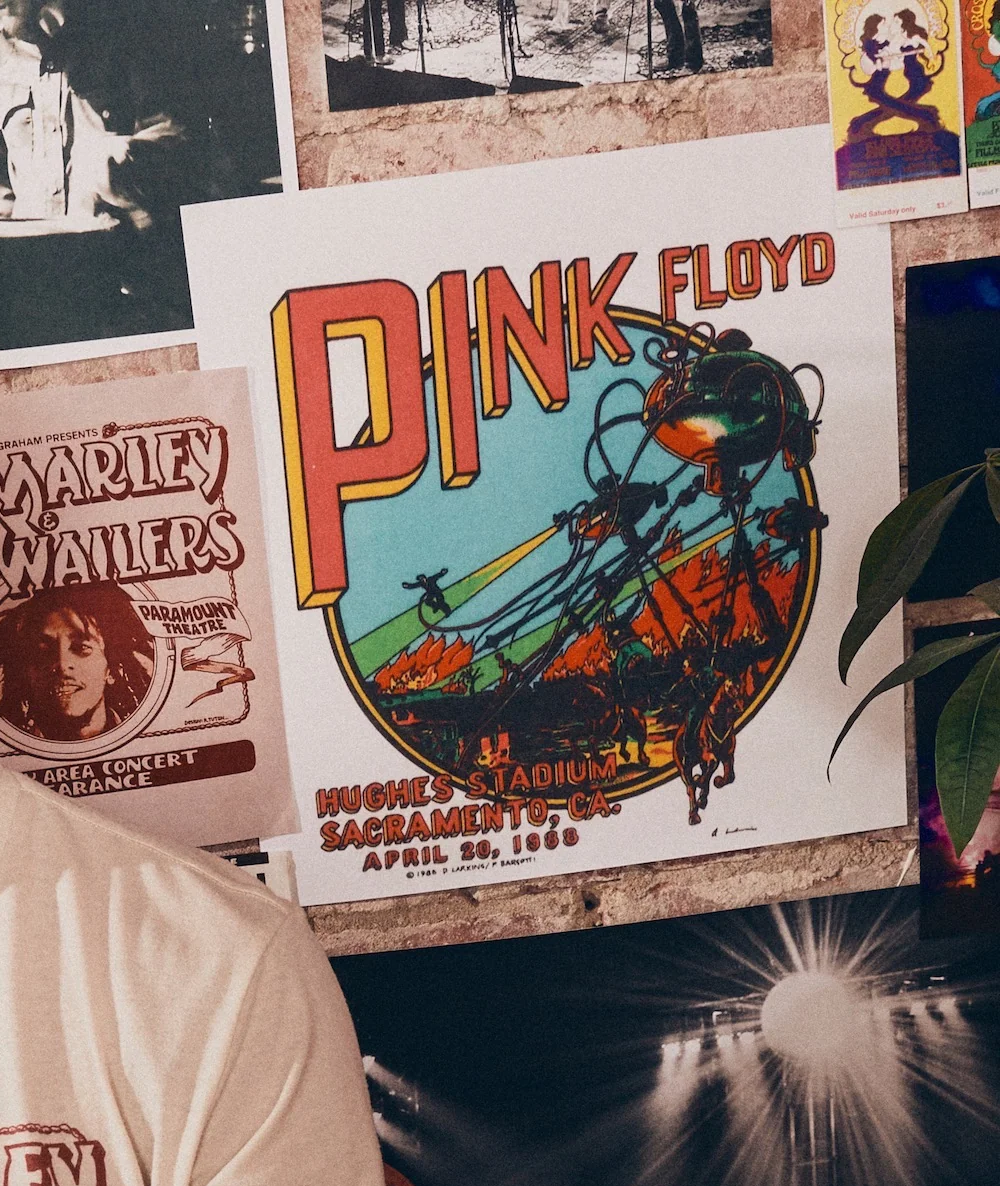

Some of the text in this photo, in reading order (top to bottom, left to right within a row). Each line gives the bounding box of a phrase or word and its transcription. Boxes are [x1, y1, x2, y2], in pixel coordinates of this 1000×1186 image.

[849, 208, 867, 220] Valid
[869, 206, 900, 218] Saturday
[901, 206, 916, 215] only
[46, 428, 99, 443] PRESENTS
[271, 231, 836, 611] PINK FLOYD
[138, 602, 236, 623] PARAMOUNT
[162, 619, 227, 635] THEATRE
[43, 764, 95, 784] AREA
[101, 749, 198, 777] CONCERT
[50, 771, 153, 797] ARANCE
[315, 752, 618, 819] HUGHES STADIUM
[320, 786, 622, 852] SACRAMENTO, CA.
[362, 827, 580, 872] APRIL 20, 1988
